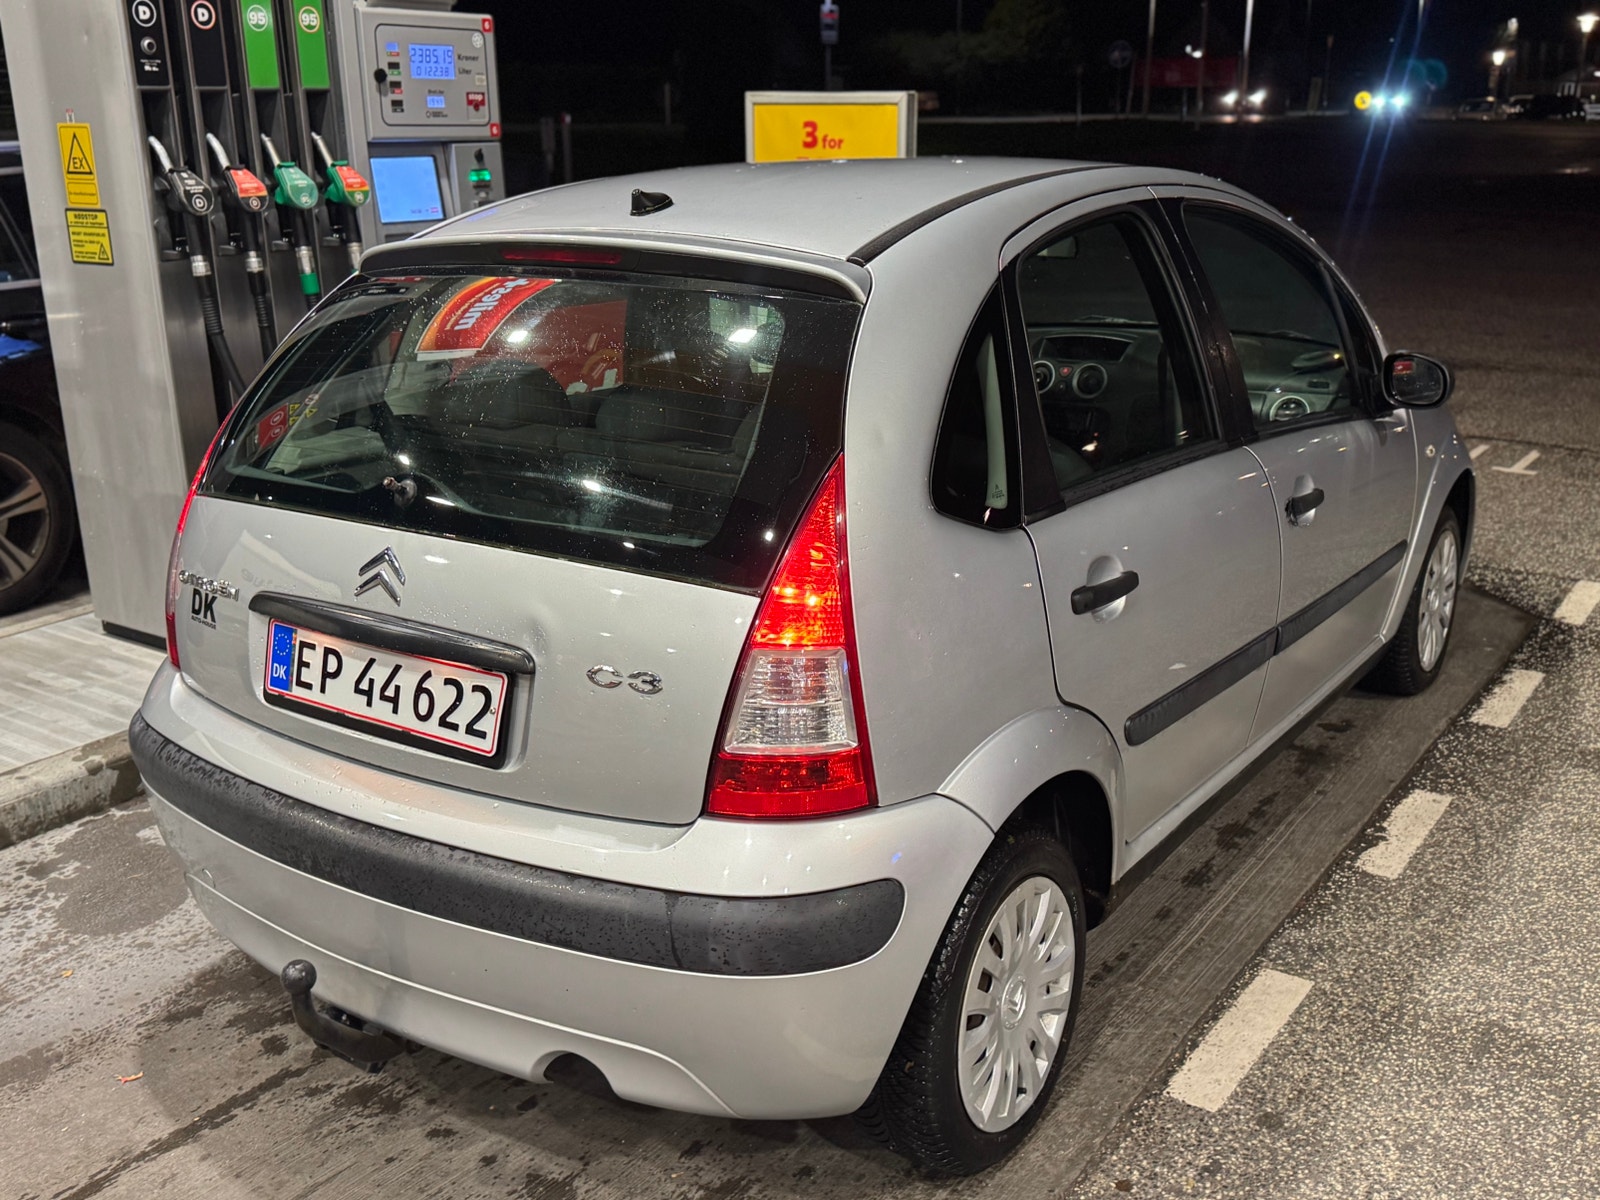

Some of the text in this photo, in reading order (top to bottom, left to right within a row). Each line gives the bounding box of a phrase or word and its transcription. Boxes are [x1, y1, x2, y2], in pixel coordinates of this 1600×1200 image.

[138, 5, 150, 20] D
[197, 8, 209, 22] D
[249, 11, 266, 25] 95
[301, 13, 317, 26] 95
[484, 20, 490, 30] 6
[492, 126, 498, 135] 6
[803, 121, 844, 149] 3 for
[72, 157, 85, 169] EX
[191, 588, 218, 623] DK
[272, 663, 287, 680] DK
[295, 640, 344, 694] EP
[586, 664, 663, 695] C3
